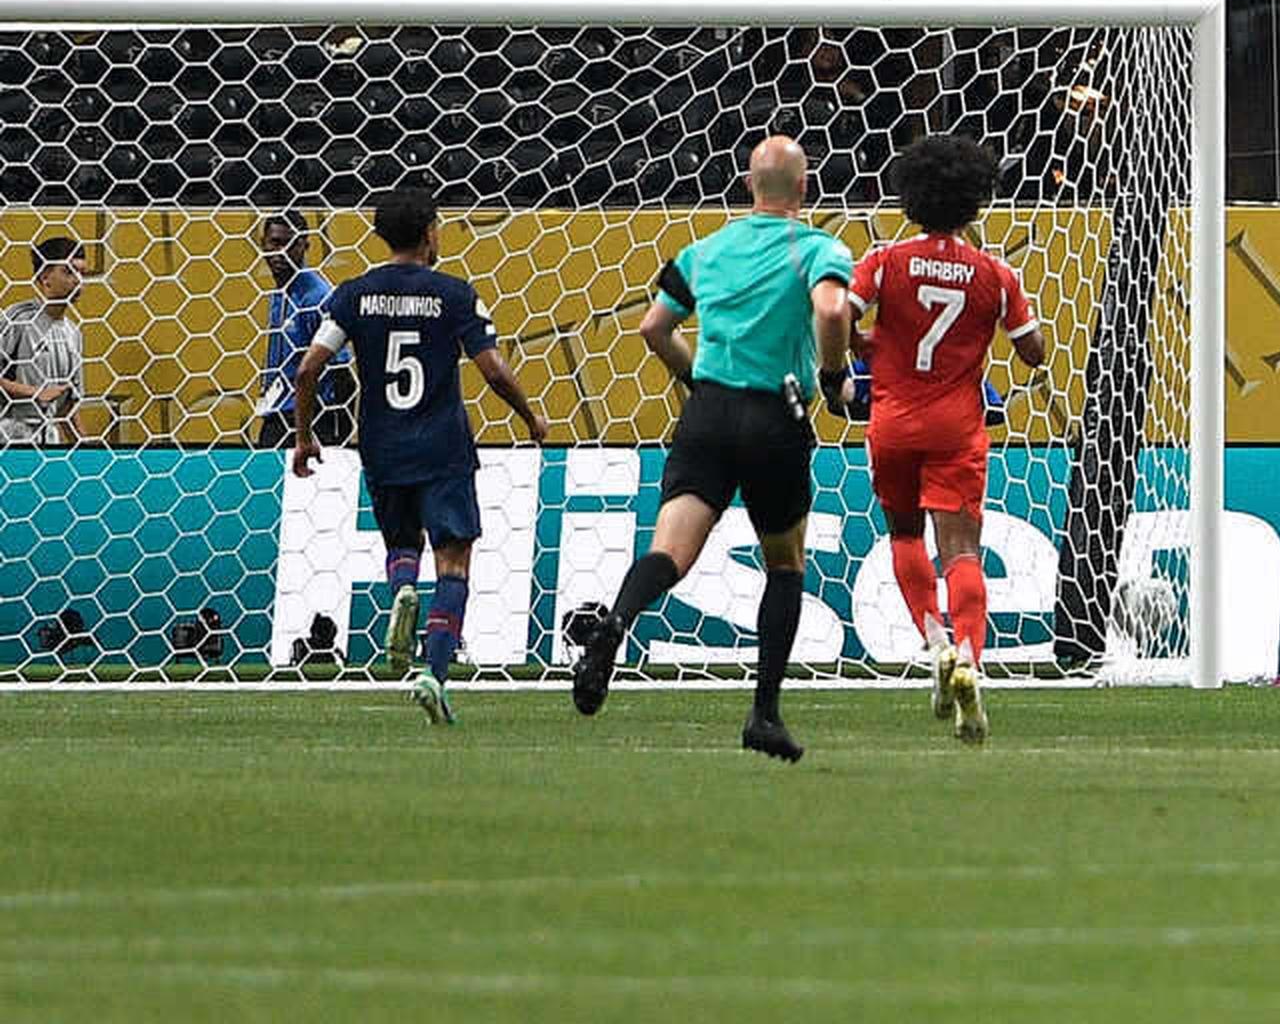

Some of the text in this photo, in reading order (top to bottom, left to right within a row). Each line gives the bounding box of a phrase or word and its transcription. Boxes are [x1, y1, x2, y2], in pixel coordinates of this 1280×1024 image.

[909, 256, 975, 283] GNABRY
[360, 294, 443, 318] MARQUINHOS
[916, 284, 966, 372] 7
[385, 331, 424, 410] 5
